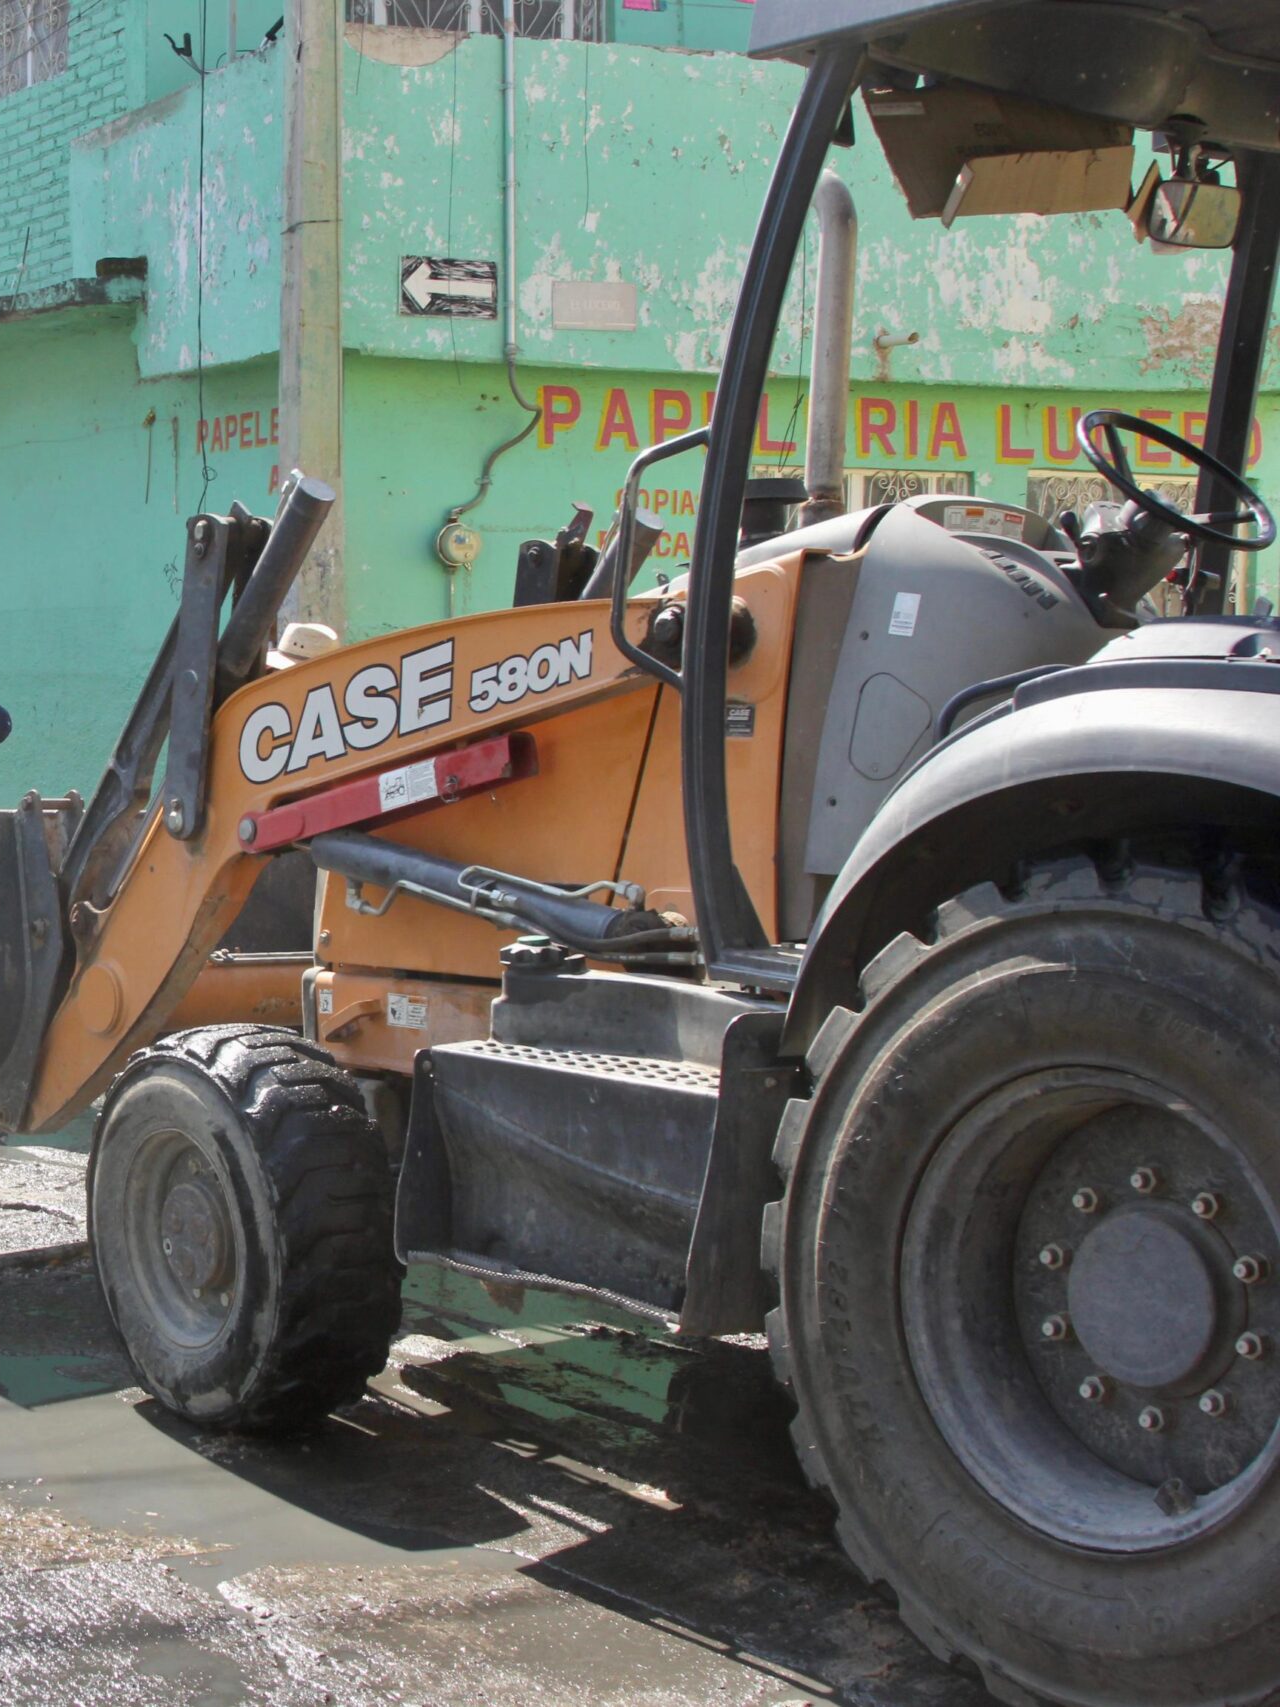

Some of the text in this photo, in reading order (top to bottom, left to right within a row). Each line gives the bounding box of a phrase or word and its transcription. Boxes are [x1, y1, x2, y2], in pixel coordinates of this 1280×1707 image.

[537, 385, 967, 460] PAPLRIA
[615, 488, 699, 516] OPIA
[239, 629, 593, 784] CASE 580N
